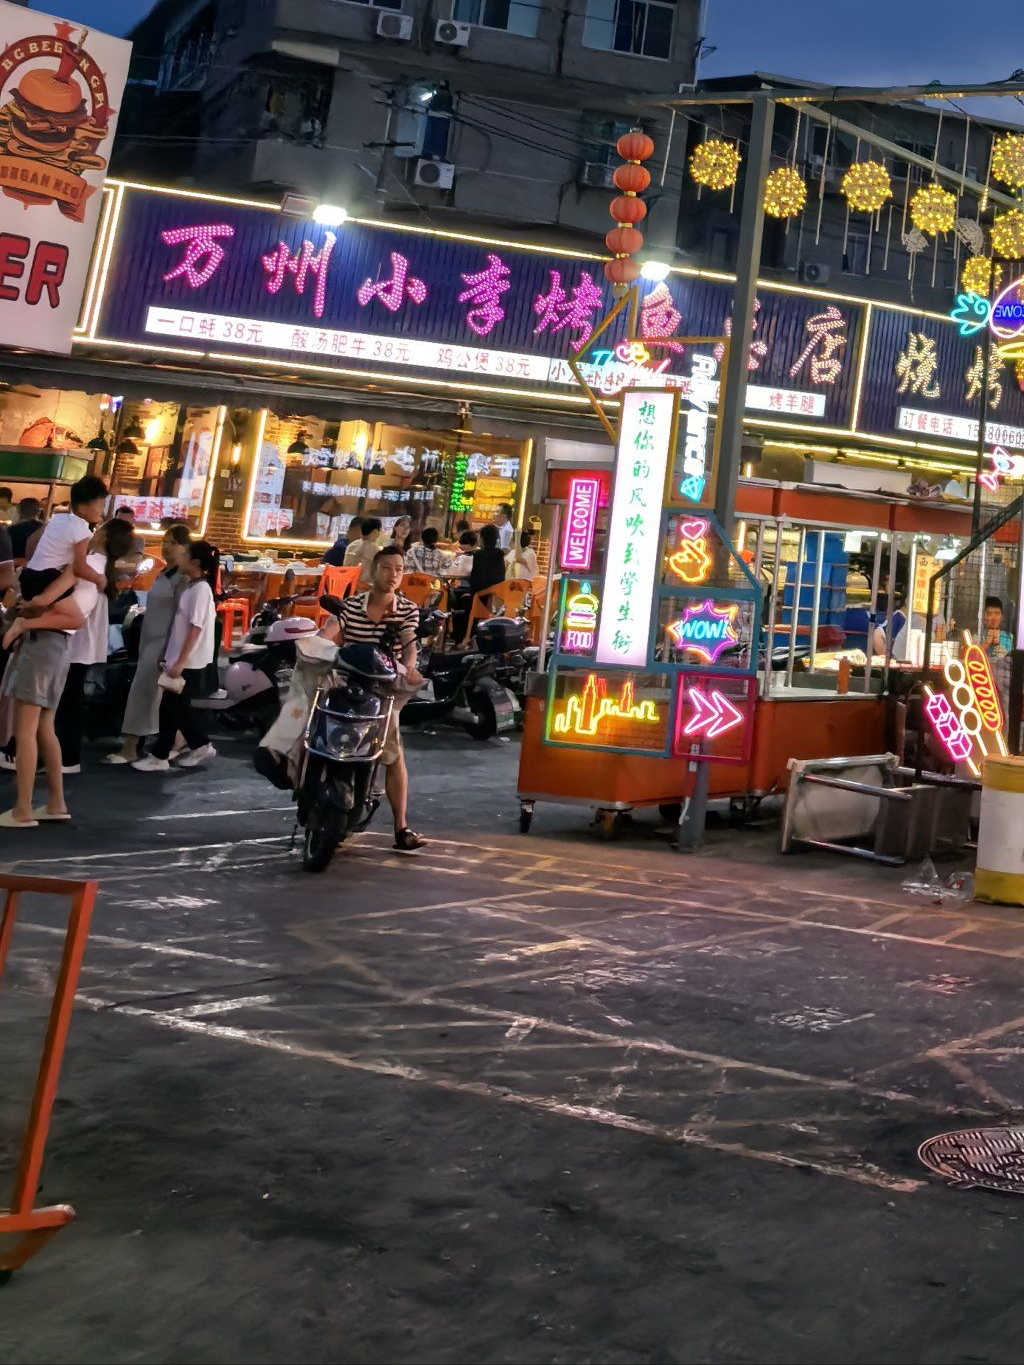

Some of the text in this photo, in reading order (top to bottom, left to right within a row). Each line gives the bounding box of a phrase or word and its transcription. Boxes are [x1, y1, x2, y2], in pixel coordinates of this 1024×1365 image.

[162, 224, 847, 384] 万州小李烤鱼店
[290, 329, 411, 362] 酸汤肥牛38元
[437, 348, 531, 378] 鸡公煲38元
[768, 390, 815, 414] 烤羊腿
[569, 483, 593, 561] WELCOME
[566, 630, 594, 649] FOOD
[680, 619, 730, 640] WOW!
